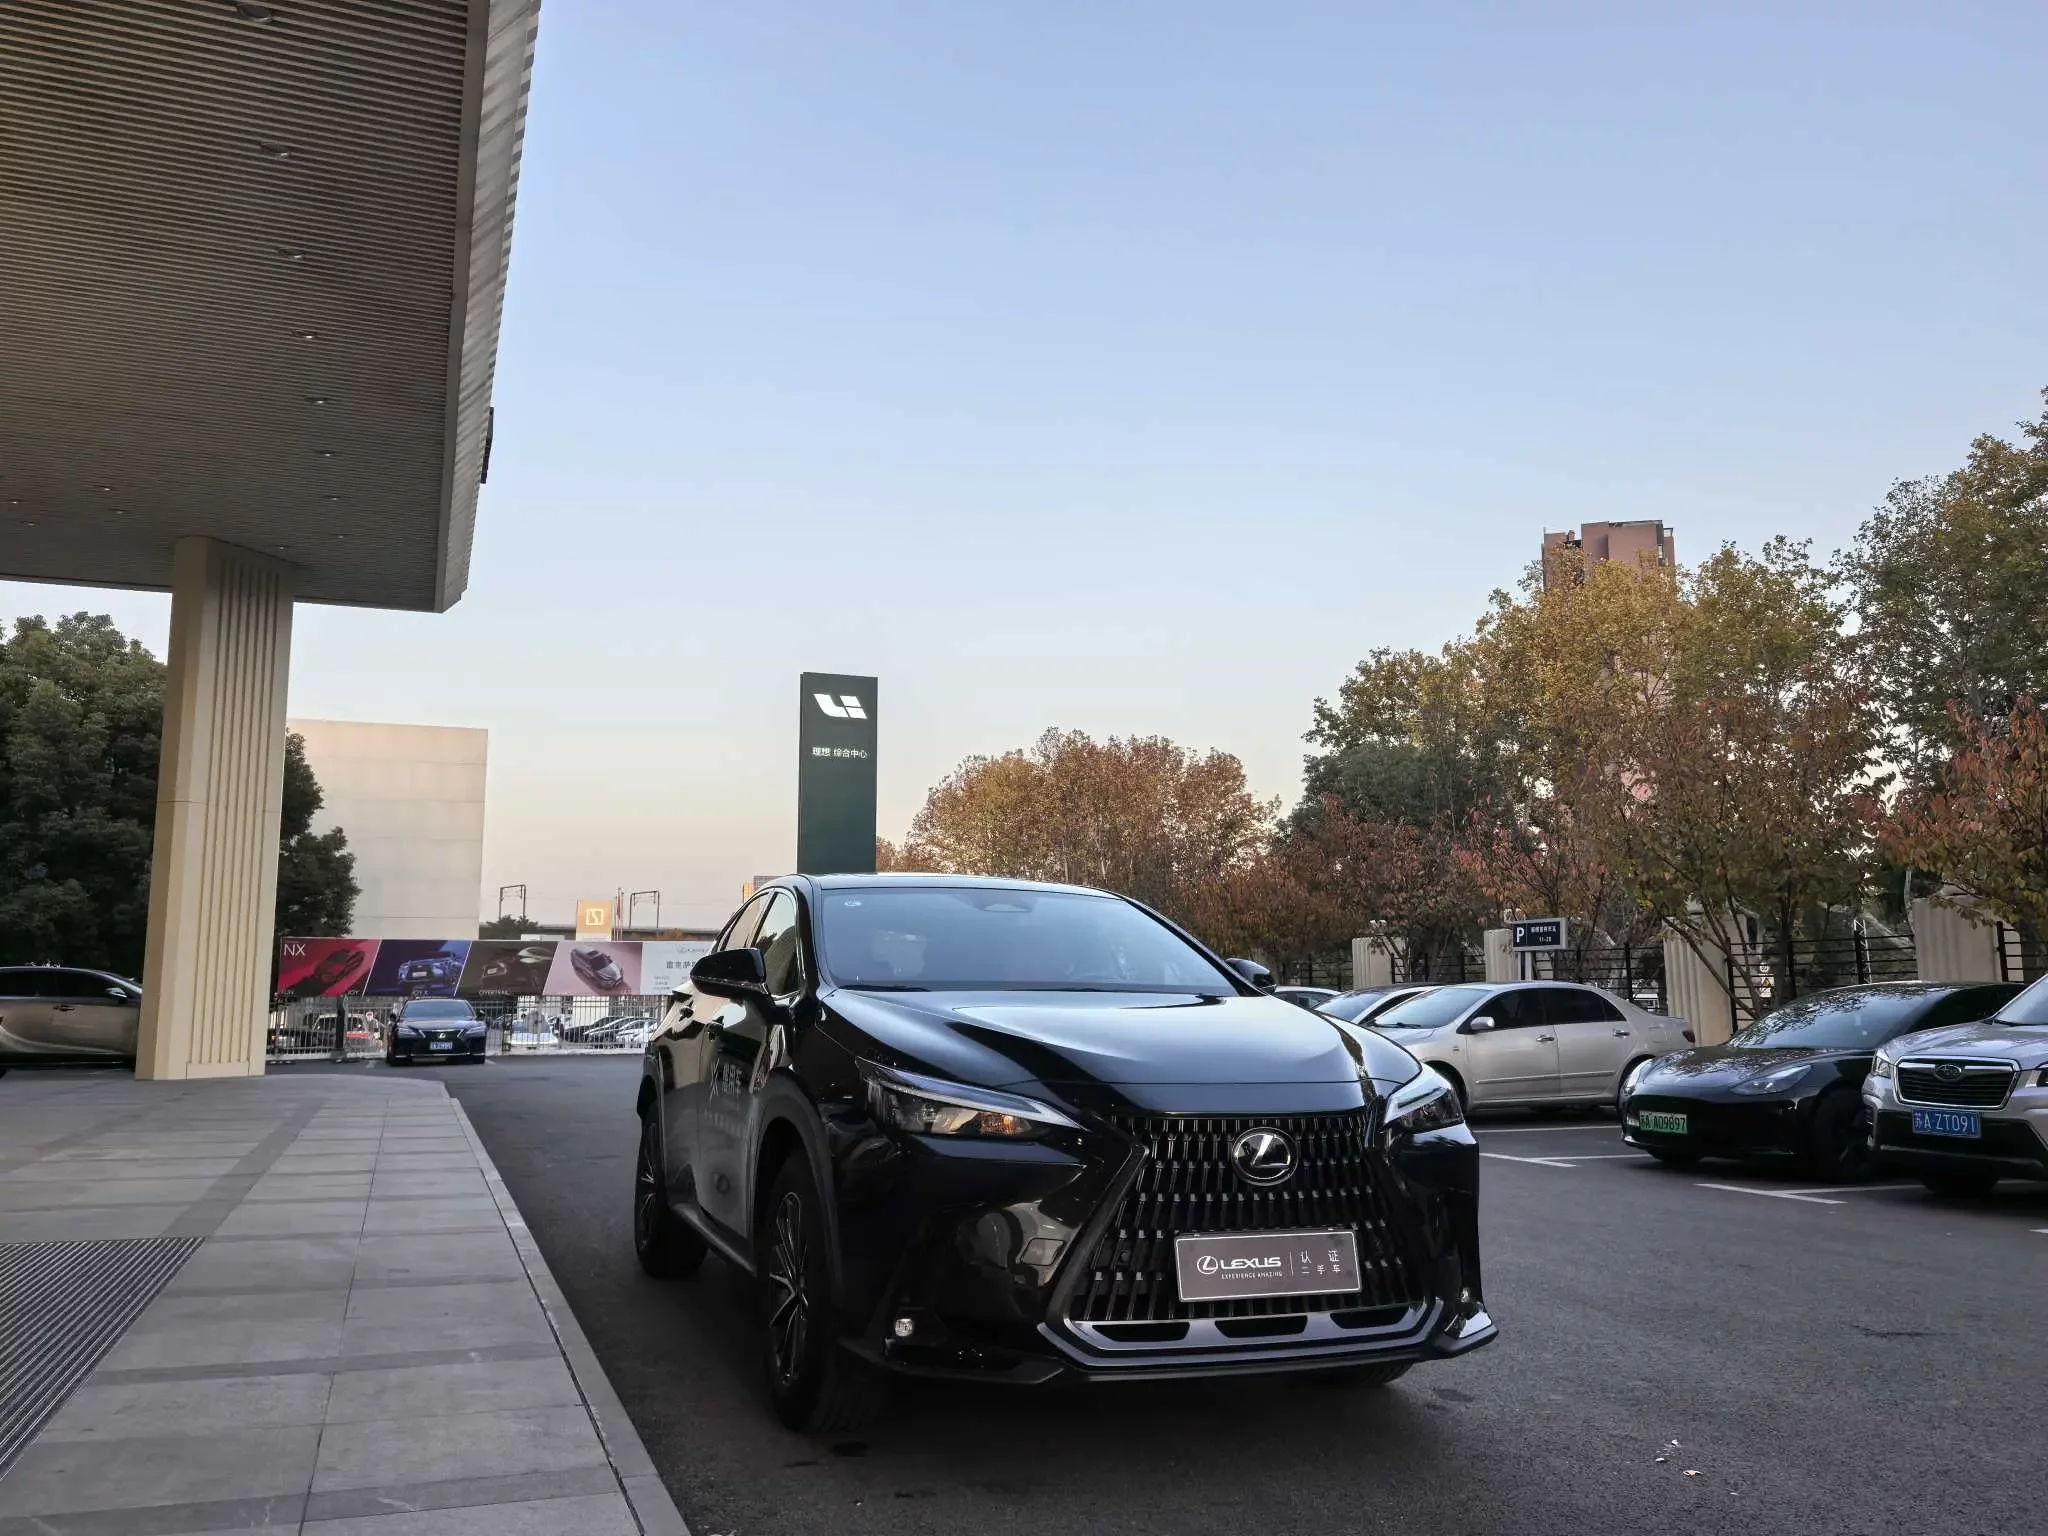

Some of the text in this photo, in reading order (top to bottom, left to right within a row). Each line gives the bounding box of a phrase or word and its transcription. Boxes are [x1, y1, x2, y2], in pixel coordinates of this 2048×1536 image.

[1516, 927, 1525, 943] P
[283, 943, 306, 957] NX
[1219, 1256, 1282, 1270] LEXUS
[1301, 1264, 1342, 1275] 二手车
